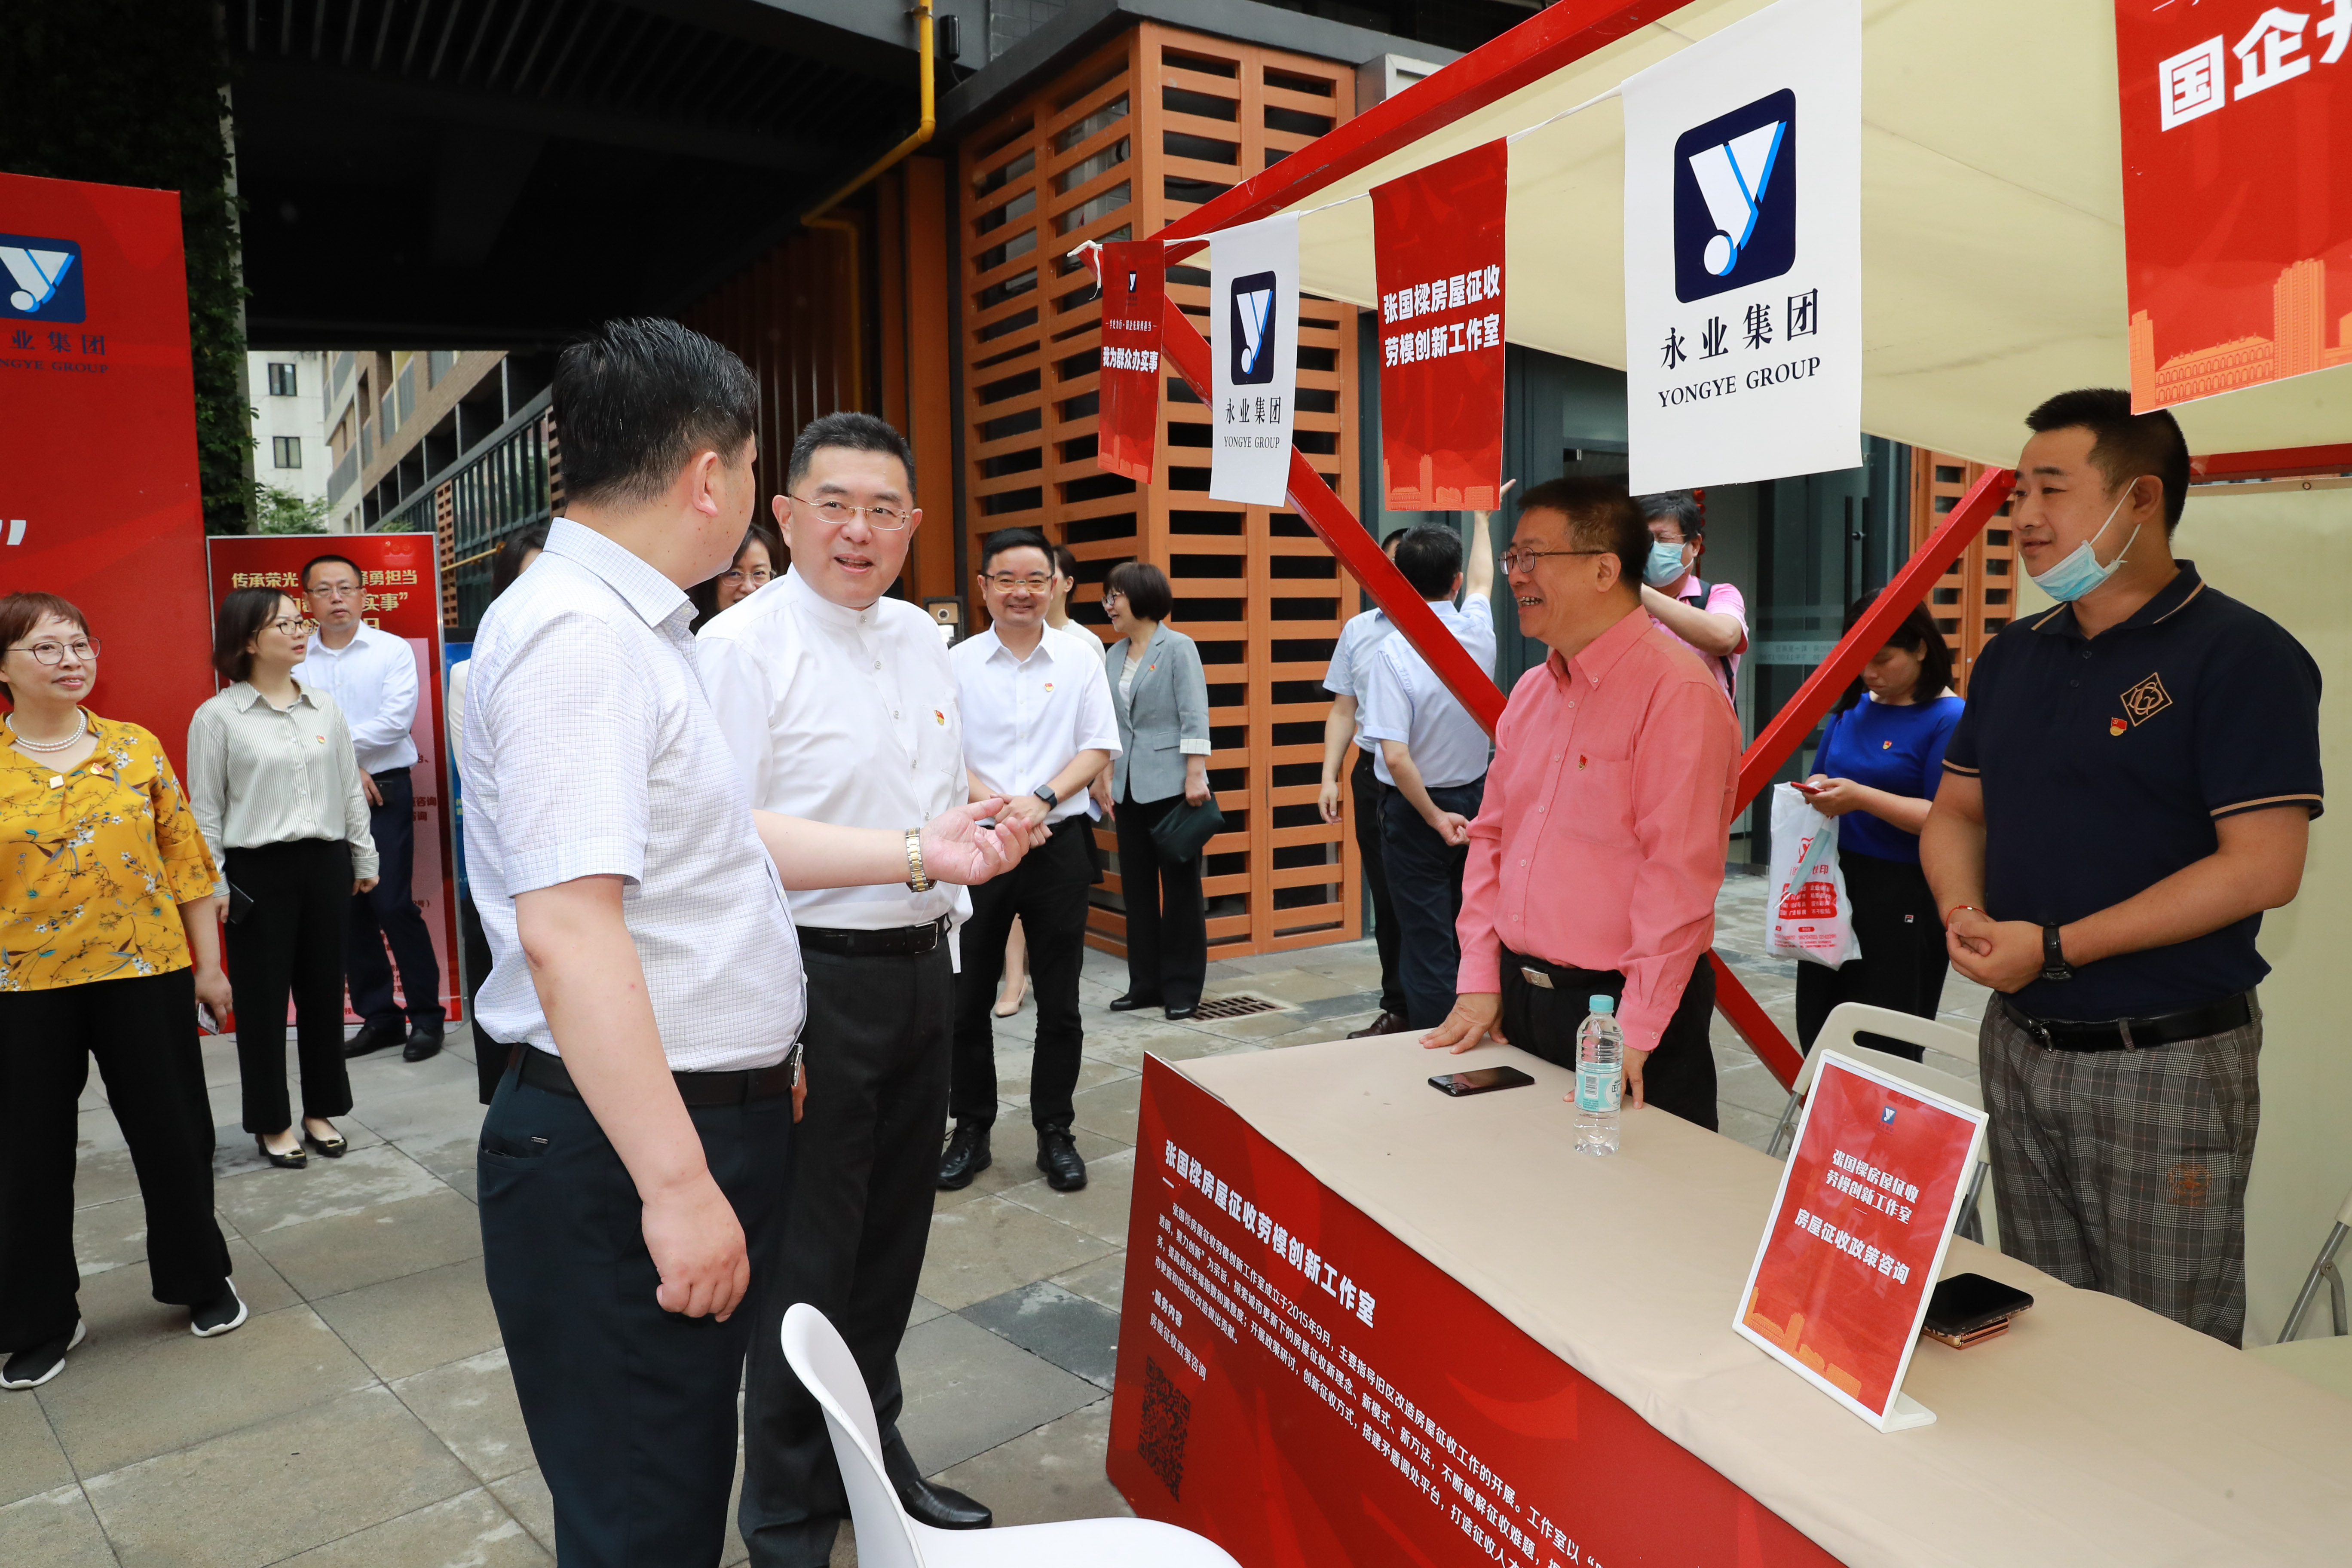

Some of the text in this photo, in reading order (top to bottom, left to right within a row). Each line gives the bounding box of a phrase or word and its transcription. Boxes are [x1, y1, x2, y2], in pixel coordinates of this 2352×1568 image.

[1383, 264, 1500, 325] 张国樑房屋征收
[1385, 313, 1499, 368] 劳模创新工作室
[1660, 288, 1818, 370] 永业集团
[52, 361, 109, 373] GROUP
[1103, 346, 1159, 373] 我为群众办实事
[1658, 357, 1820, 407] YONGYE GROUP
[1225, 395, 1281, 424] 永业集团
[1224, 436, 1280, 449] YONGYE GROUP
[231, 572, 299, 588] 传承荣光
[1826, 1169, 1913, 1225] 劳模创新工作室
[1832, 1148, 1920, 1204] 张国樑房屋征收
[1165, 1139, 1376, 1328] 张国樑房屋征收劳模创新工作室
[1794, 1207, 1910, 1285] 房屋征收政策咨询
[1150, 1312, 1206, 1381] 房屋征收政策咨询
[1172, 1202, 1604, 1568] 张国樑房屋征收劳模创新工作室成立于2015年9月，主要指导旧区改造房屋征收工作的开展。工作室以“
